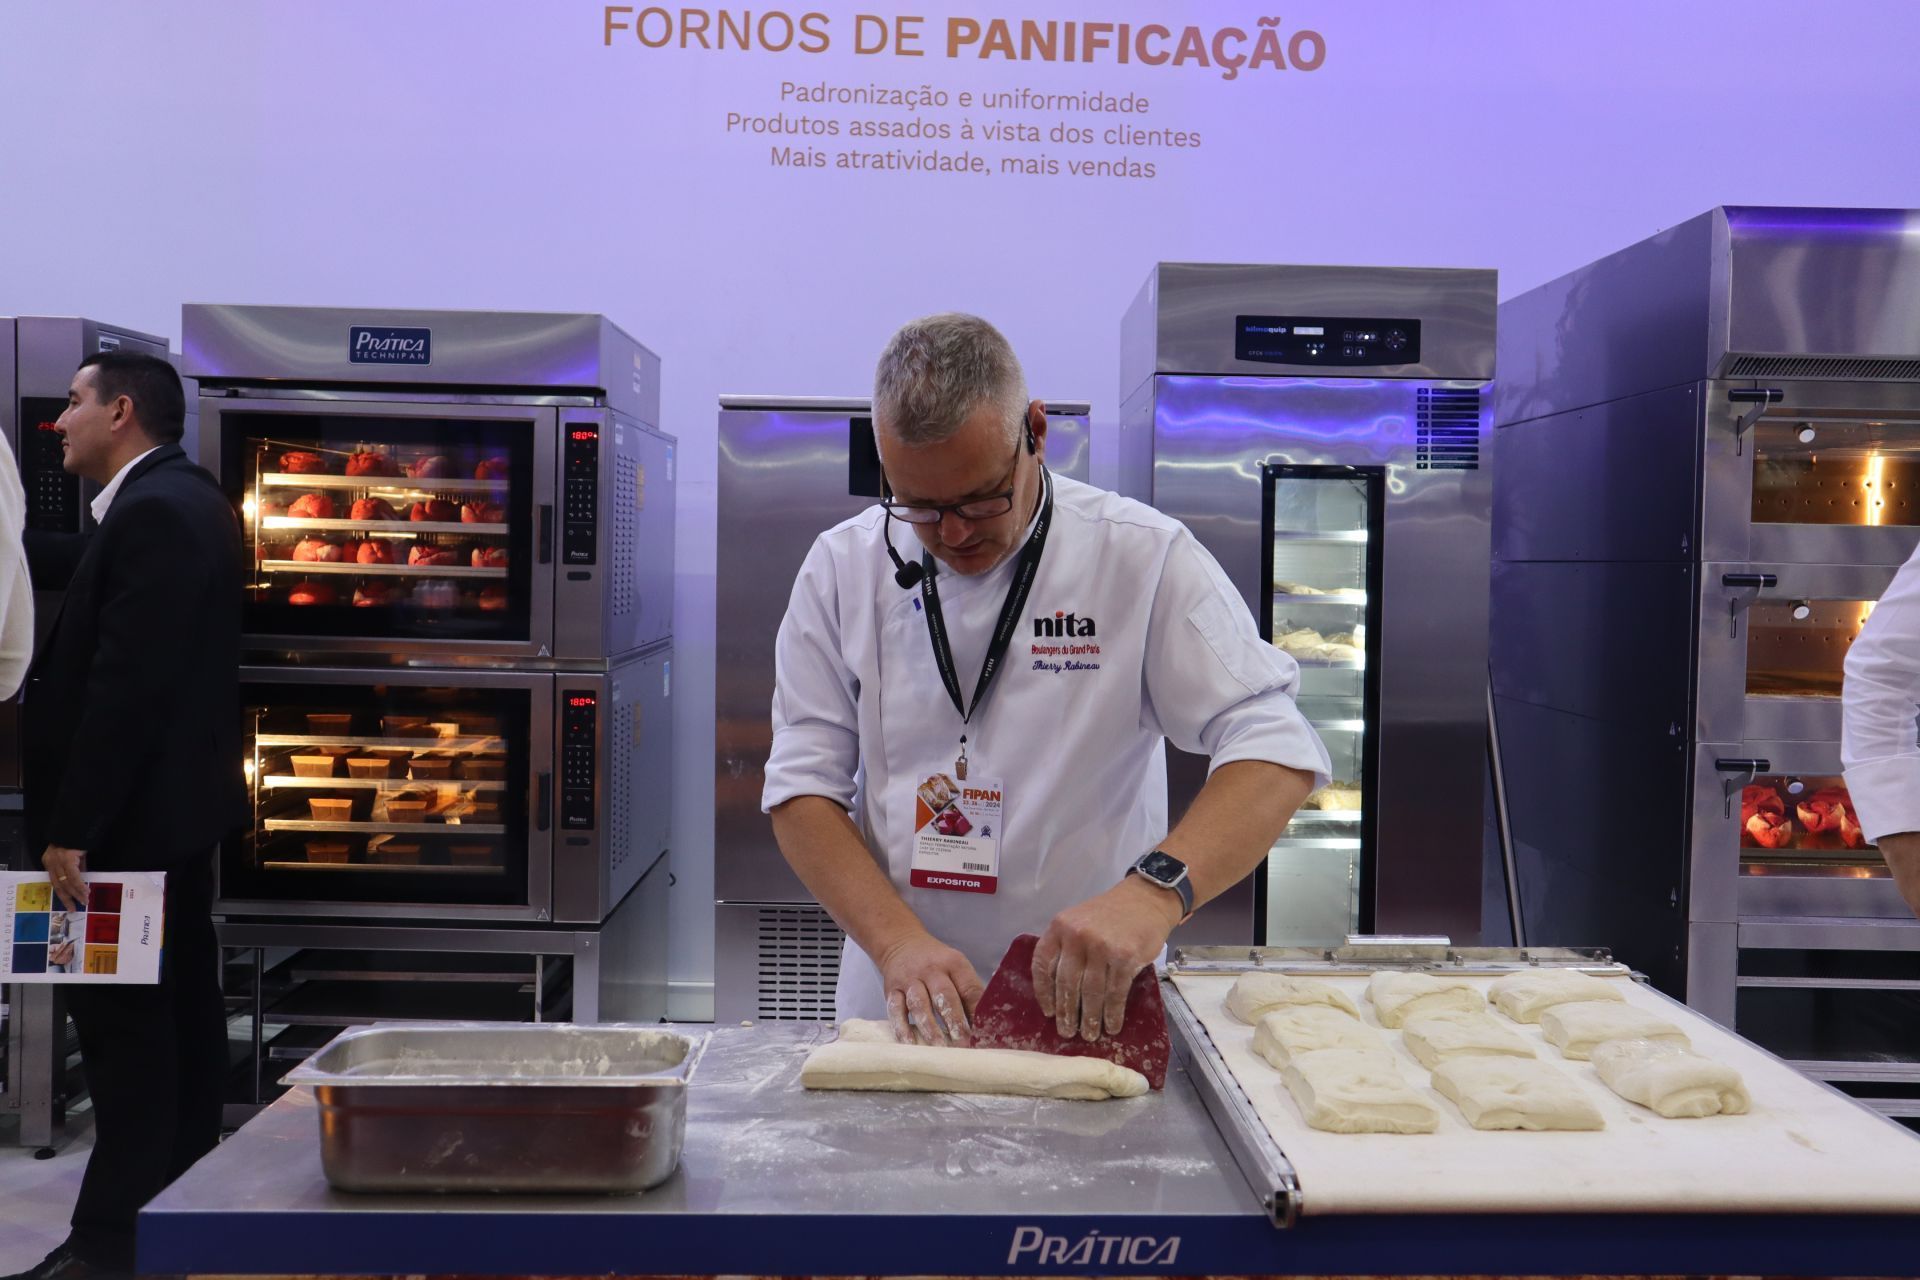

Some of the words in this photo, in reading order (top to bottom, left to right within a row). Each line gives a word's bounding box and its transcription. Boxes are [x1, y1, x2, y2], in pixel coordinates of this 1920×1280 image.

[603, 5, 831, 53] FORNOS
[854, 14, 925, 57] DE
[946, 16, 1327, 81] PANIFICAÇÃO
[780, 81, 949, 111] Padronização
[958, 90, 972, 107] e
[982, 87, 1150, 114] uniformidade
[726, 112, 840, 136] Produtos
[849, 116, 951, 140] assados
[960, 118, 975, 141] à
[982, 120, 1041, 143] vista
[1049, 121, 1095, 144] dos
[1103, 123, 1202, 148] clientes
[769, 145, 826, 168] Mais
[836, 149, 992, 176] atratividade,
[1000, 153, 1059, 175] mais
[1067, 155, 1157, 179] vendas
[356, 351, 425, 360] TECHNIPAN
[1034, 610, 1096, 637] nita
[1031, 644, 1061, 656] Boulangers
[1061, 644, 1069, 655] du
[1069, 644, 1086, 655] Grand
[1086, 643, 1100, 655] Paris
[1032, 660, 1062, 674] Thierry
[963, 788, 1001, 801] FIPAN
[927, 876, 981, 888] EXPOSITOR
[1007, 1226, 1181, 1265] PRÁTICA
